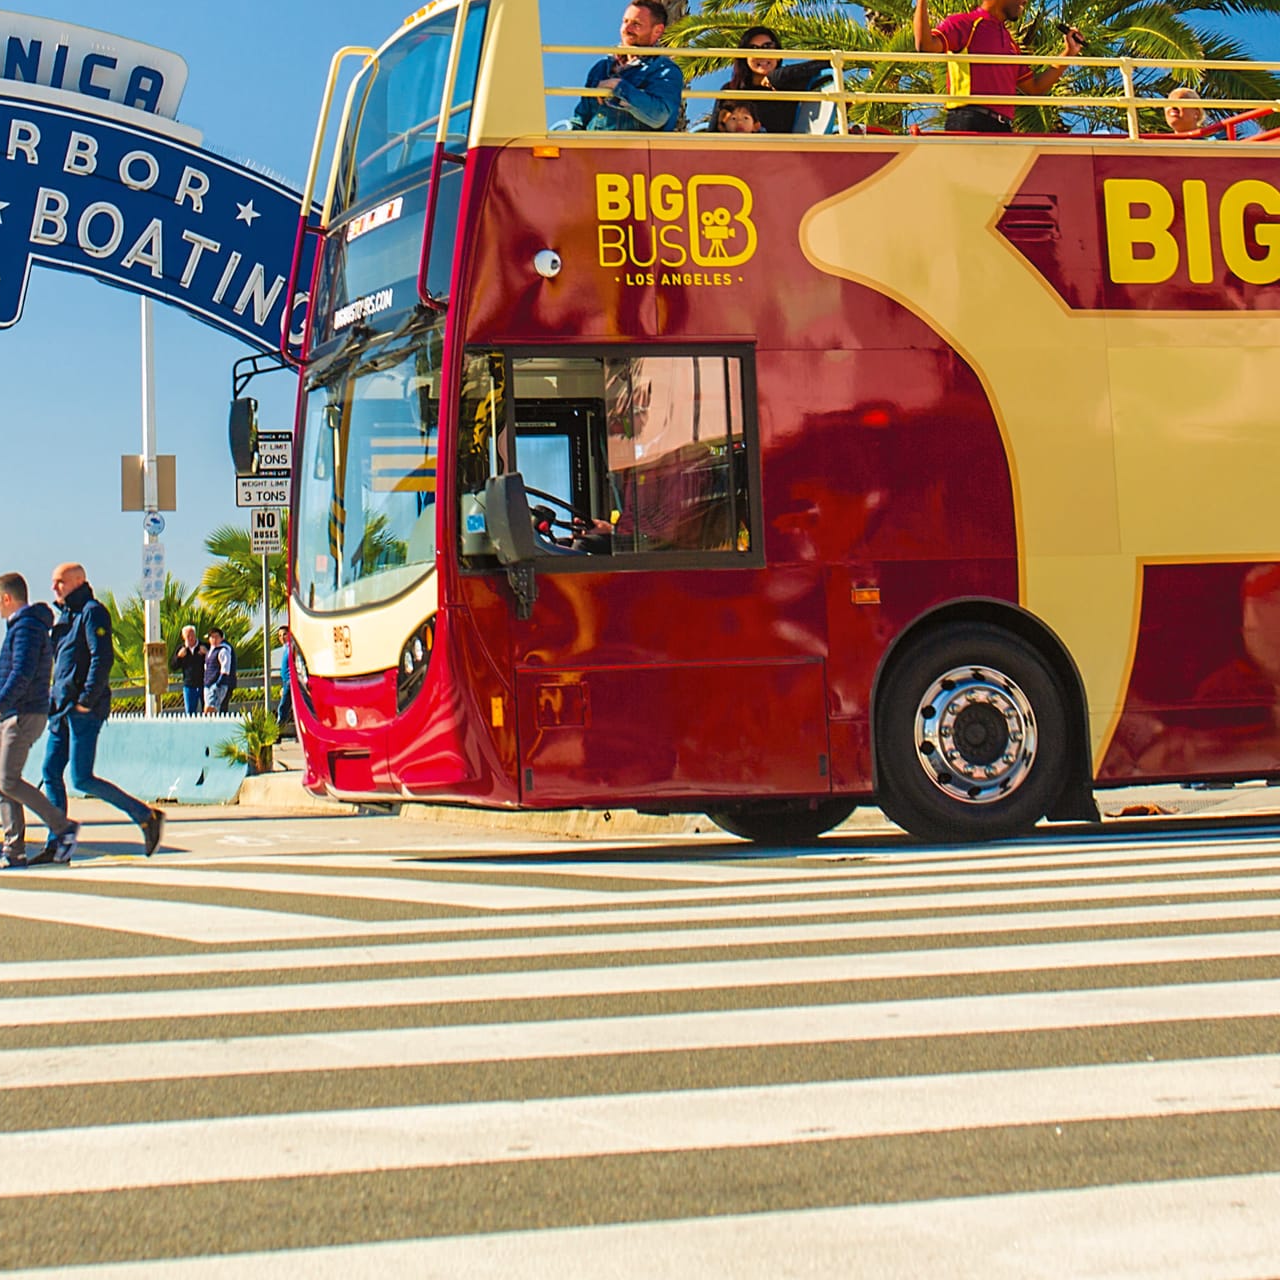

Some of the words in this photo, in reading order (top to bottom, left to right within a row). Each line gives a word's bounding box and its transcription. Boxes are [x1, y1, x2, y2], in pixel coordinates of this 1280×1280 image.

[596, 173, 685, 221] BIG
[598, 224, 687, 267] BUS
[29, 187, 311, 345] BOATING
[626, 273, 655, 286] LOS
[661, 273, 732, 286] ANGELES
[259, 454, 288, 465] TONS
[244, 491, 252, 501] 3
[256, 491, 286, 502] TONS
[257, 512, 275, 528] NO
[254, 531, 279, 539] BUSES
